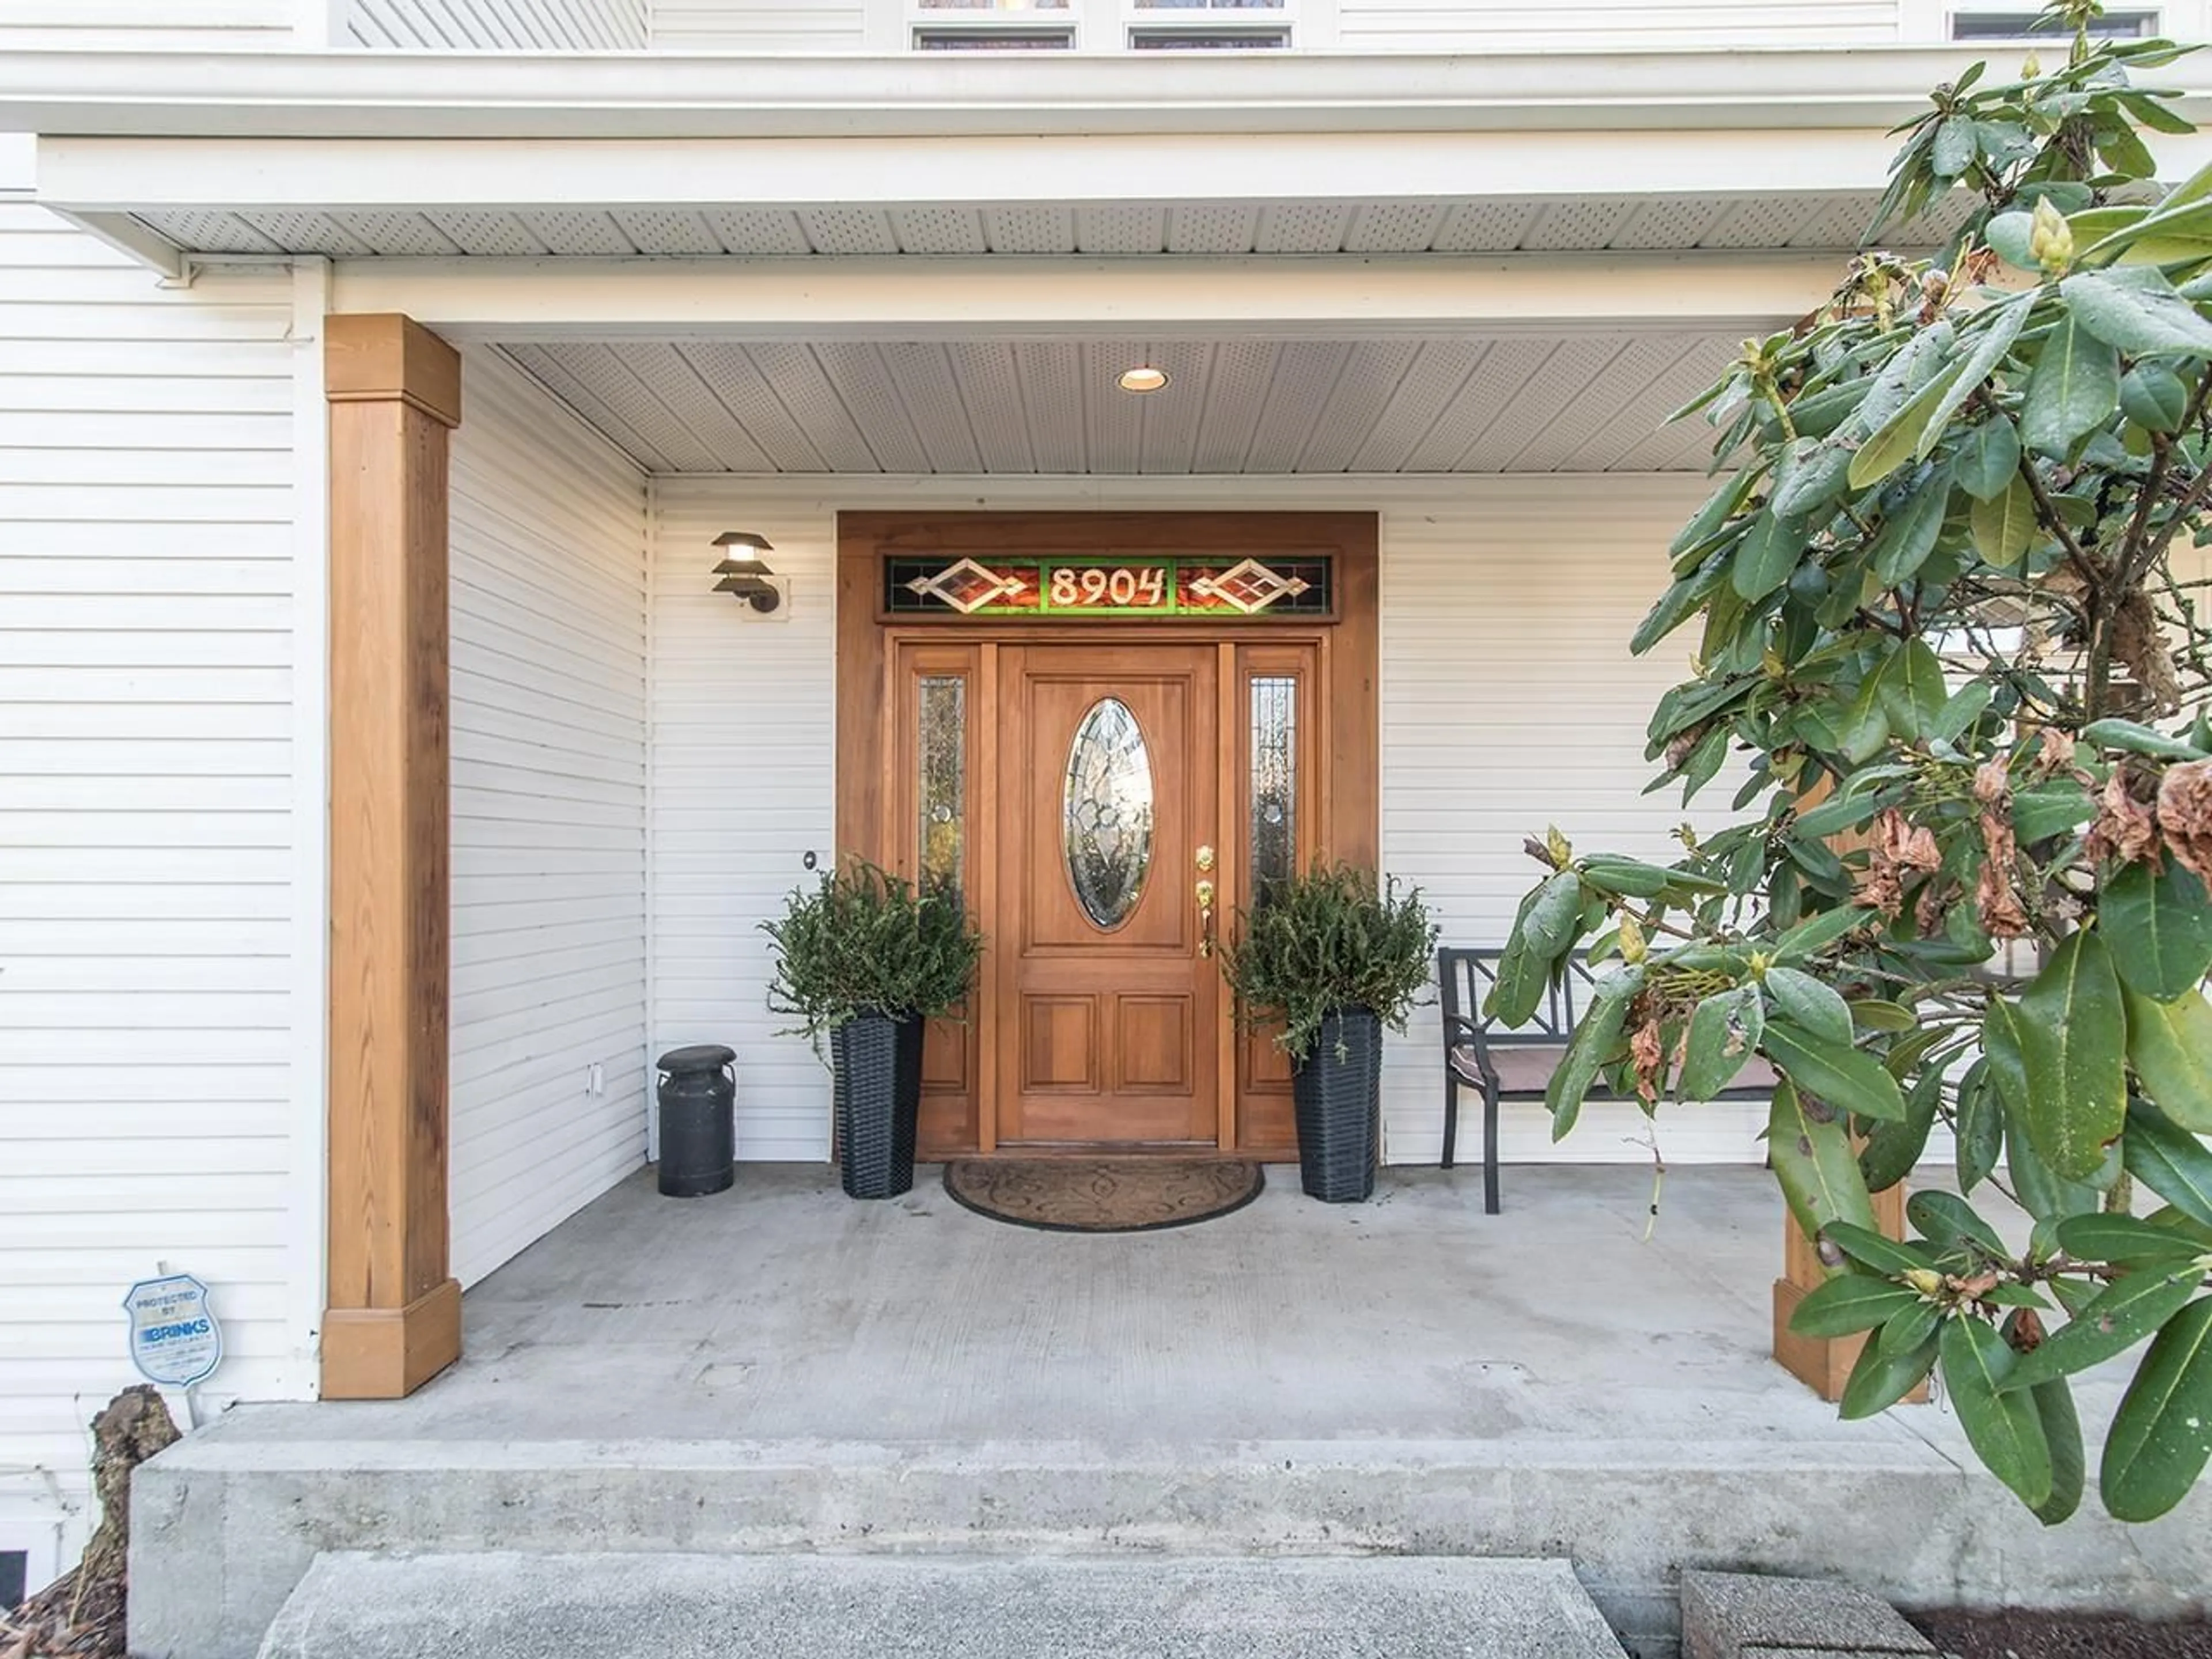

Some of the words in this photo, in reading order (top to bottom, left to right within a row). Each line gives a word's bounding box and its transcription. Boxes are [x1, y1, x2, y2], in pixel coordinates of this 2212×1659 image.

[1052, 568, 1165, 605] 8904
[136, 1291, 197, 1308] PROTECTED
[150, 1319, 210, 1342] BRINKS
